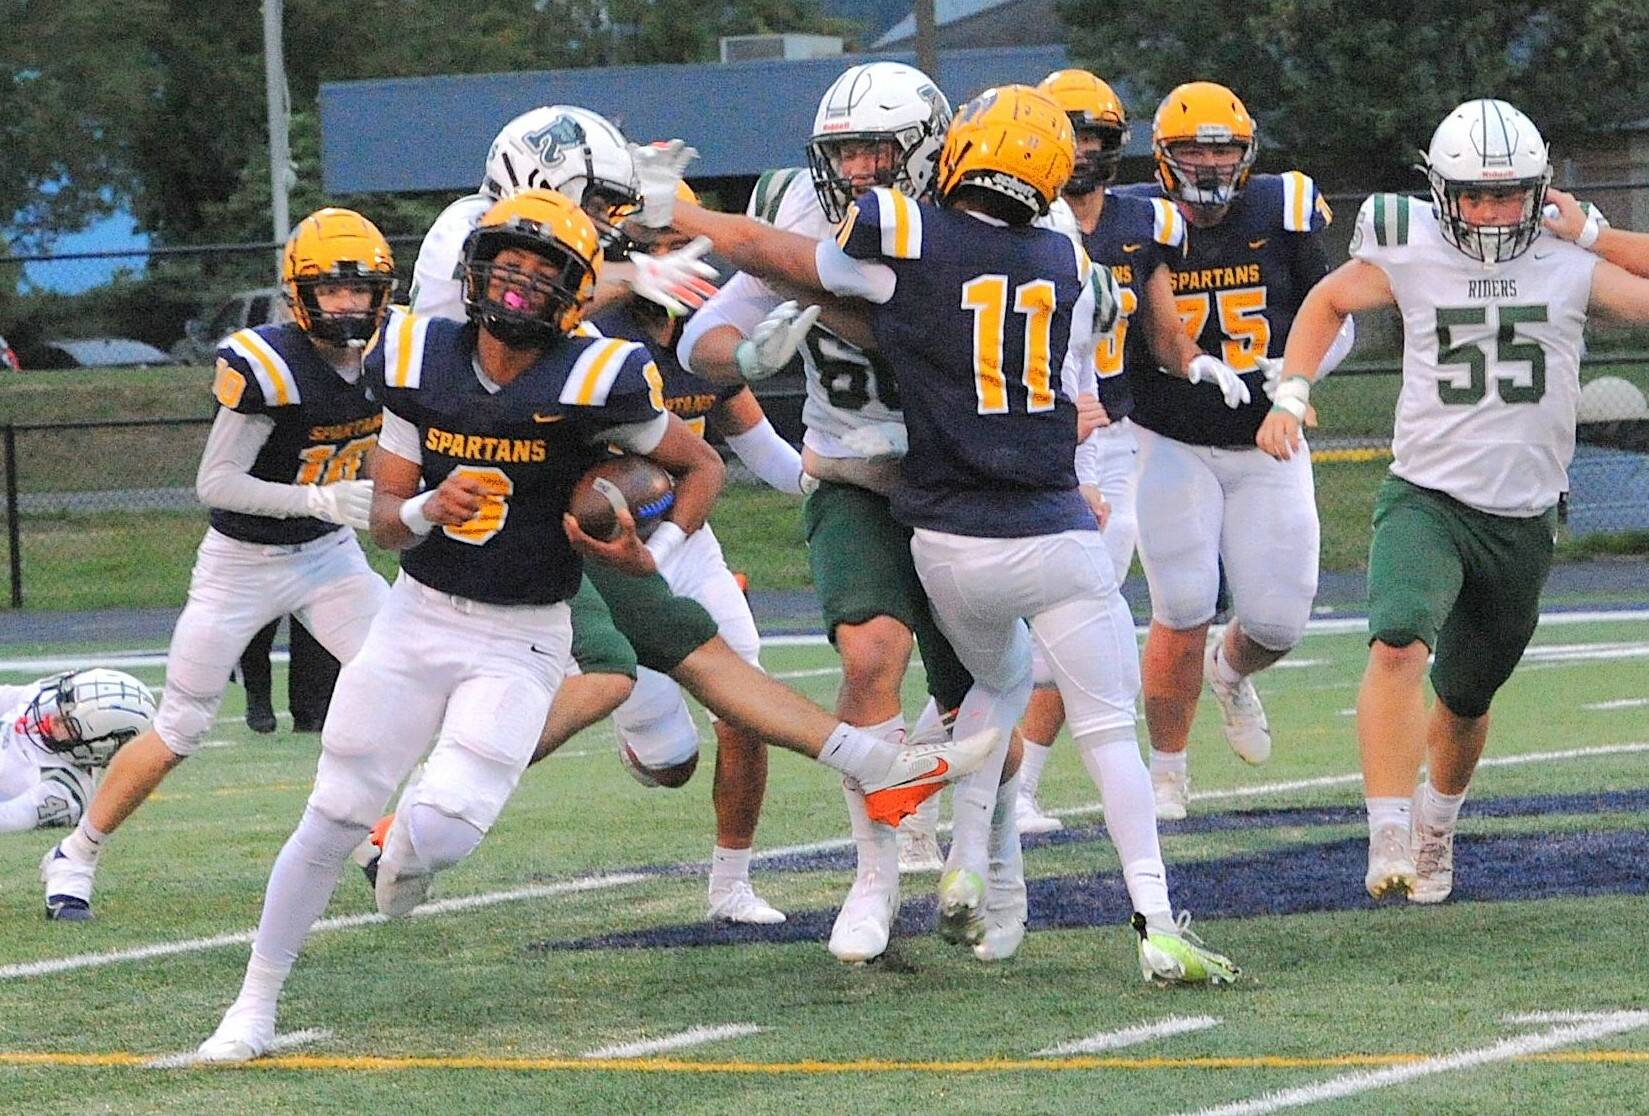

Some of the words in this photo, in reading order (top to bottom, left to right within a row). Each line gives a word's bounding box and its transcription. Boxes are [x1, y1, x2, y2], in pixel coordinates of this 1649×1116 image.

[1170, 264, 1260, 291] SPARTANS
[1468, 278, 1517, 299] RIDERS
[961, 273, 1056, 415] 11
[1436, 303, 1548, 405] 55
[425, 426, 547, 463] SPARTANS
